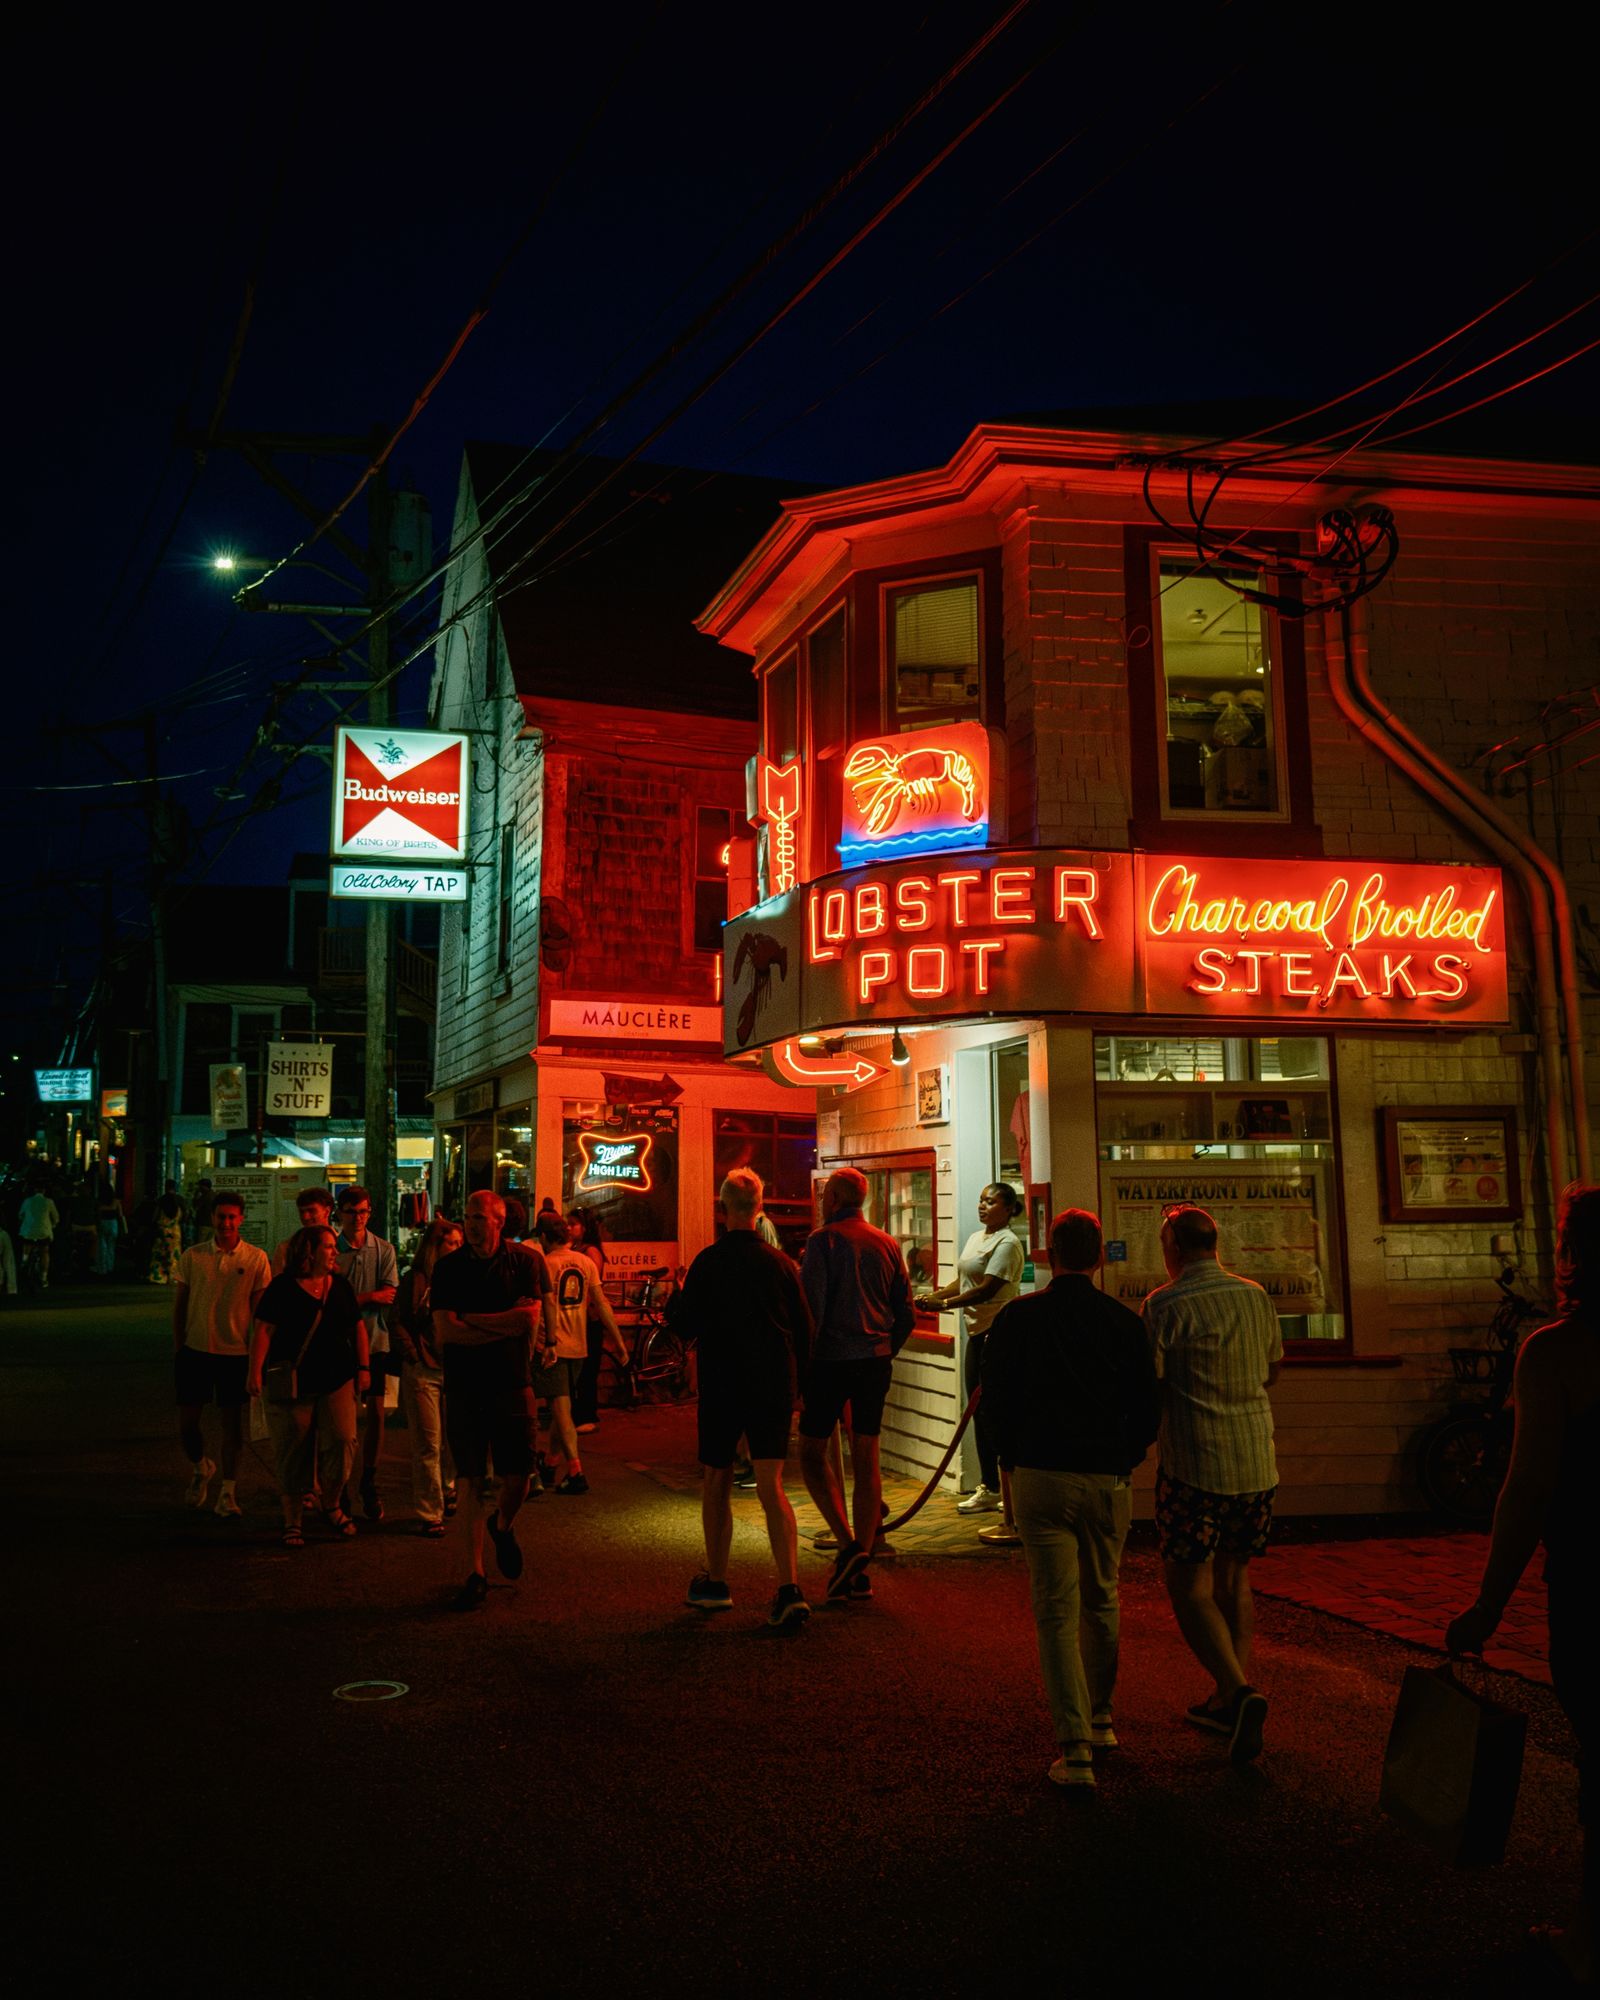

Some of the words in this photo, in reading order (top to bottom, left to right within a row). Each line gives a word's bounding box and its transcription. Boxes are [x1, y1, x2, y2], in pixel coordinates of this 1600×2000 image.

[355, 837, 383, 847] KING
[386, 839, 401, 848] OF
[403, 840, 438, 849] BEERS
[342, 873, 372, 889] Old
[370, 874, 419, 894] Colony
[424, 876, 458, 892] TAP
[809, 866, 1104, 963] LOBSTER
[1148, 864, 1349, 952] Charcoal
[859, 939, 1005, 1003] POT
[1190, 949, 1470, 1002] STEAKS
[582, 1008, 692, 1029] MAUCLÈRE
[270, 1060, 329, 1077] SHIRTS
[272, 1093, 325, 1109] STUFF
[593, 1143, 636, 1164] Miller
[215, 1175, 239, 1185] RENT
[588, 1163, 615, 1176] HIGH
[616, 1165, 640, 1178] LIFE
[1116, 1182, 1237, 1201] WATERFRONT
[1246, 1182, 1313, 1201] DINING
